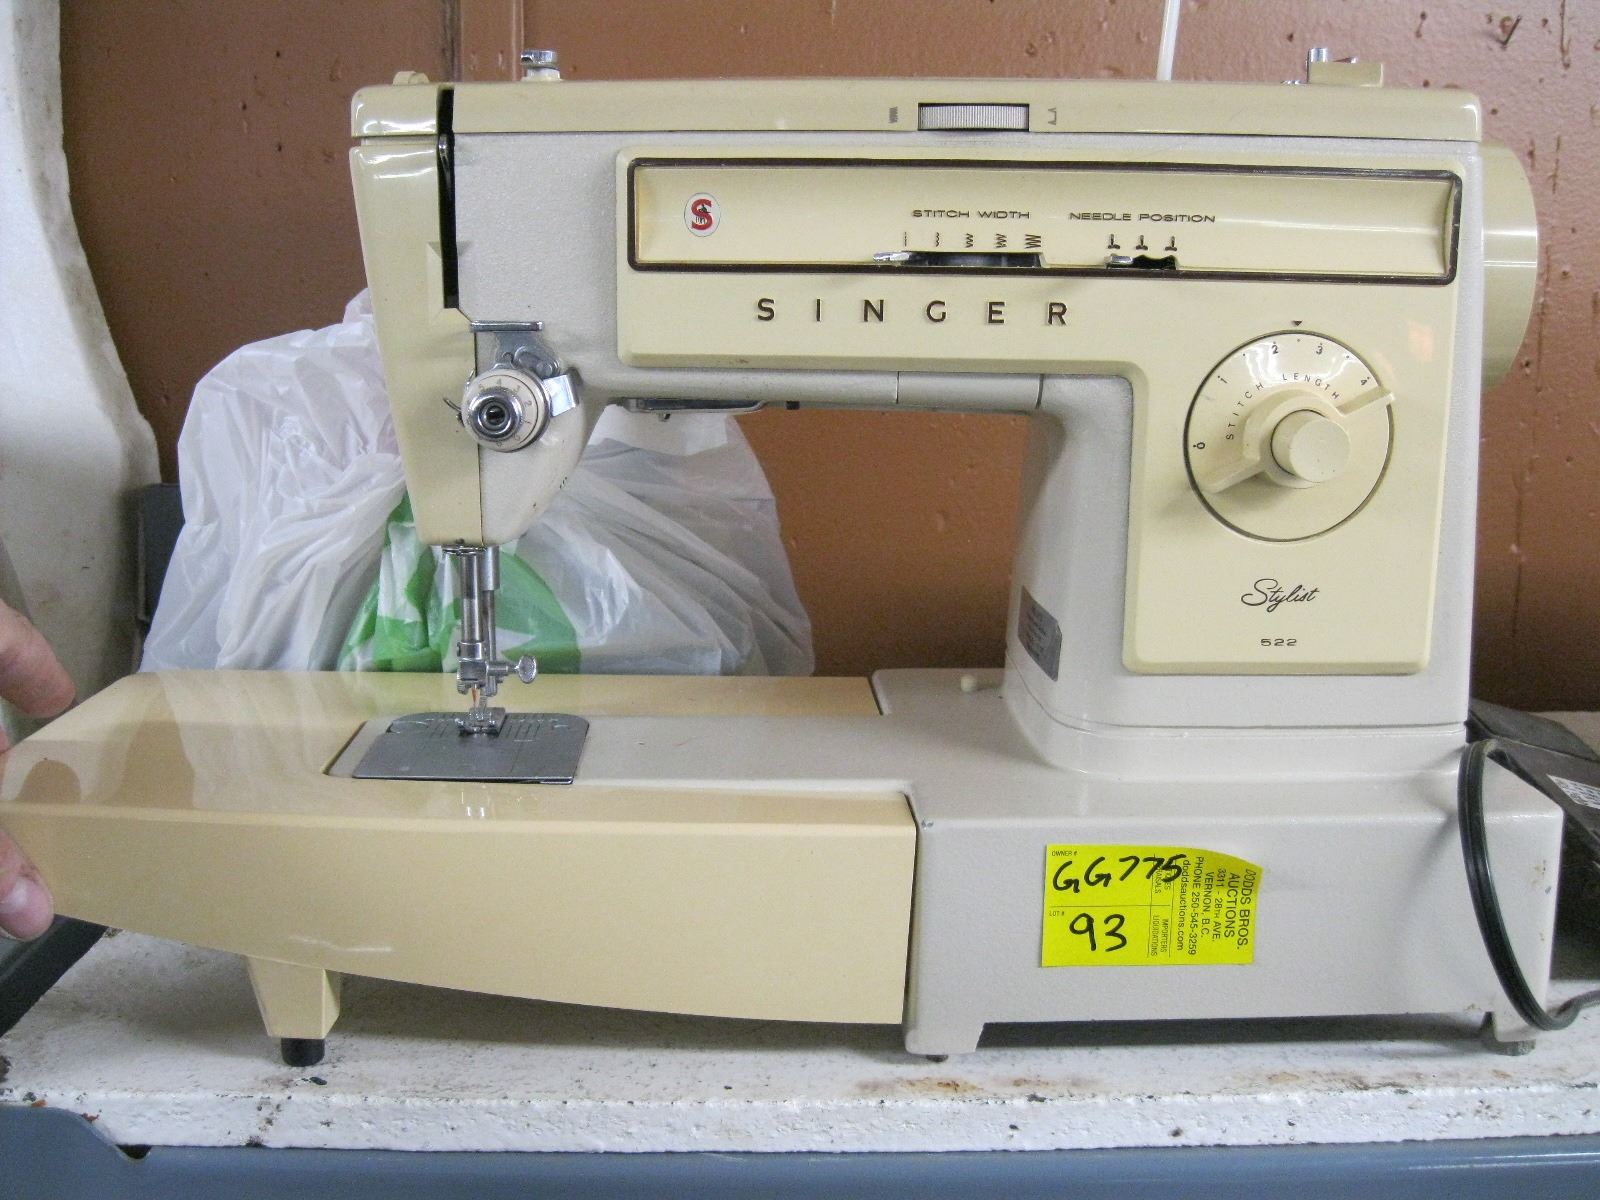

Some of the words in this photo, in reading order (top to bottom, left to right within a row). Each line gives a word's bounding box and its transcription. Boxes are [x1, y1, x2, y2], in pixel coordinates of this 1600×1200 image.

[691, 198, 713, 230] S
[912, 209, 970, 218] STITCH
[978, 210, 1030, 219] WIDTH
[1069, 212, 1131, 221] NEEDLE
[1139, 213, 1216, 223] POSITION
[757, 298, 1068, 325] SINGER
[1219, 376, 1228, 384] 1
[1271, 345, 1279, 354] 2
[1315, 345, 1324, 354] 3
[1360, 378, 1369, 386] 4
[1226, 382, 1264, 440] STITCH
[1282, 373, 1340, 399] LENGTH
[1241, 578, 1320, 612] Stylist
[1260, 638, 1297, 647] 522
[1193, 856, 1204, 889] PHONE
[1240, 868, 1257, 905] DODDS
[1177, 859, 1191, 951] doddsauctions.com
[1202, 871, 1214, 915] VERNON,
[1224, 872, 1240, 938] AUCTIONS
[1069, 913, 1127, 952] 93
[1151, 914, 1160, 957] LIQUIDATIONS
[1160, 918, 1169, 953] IMPORTERS
[1188, 891, 1200, 955] 250-545-3259
[1201, 918, 1210, 938] B.C.
[1212, 920, 1221, 941] AVE.
[1237, 909, 1250, 950] BROS.
